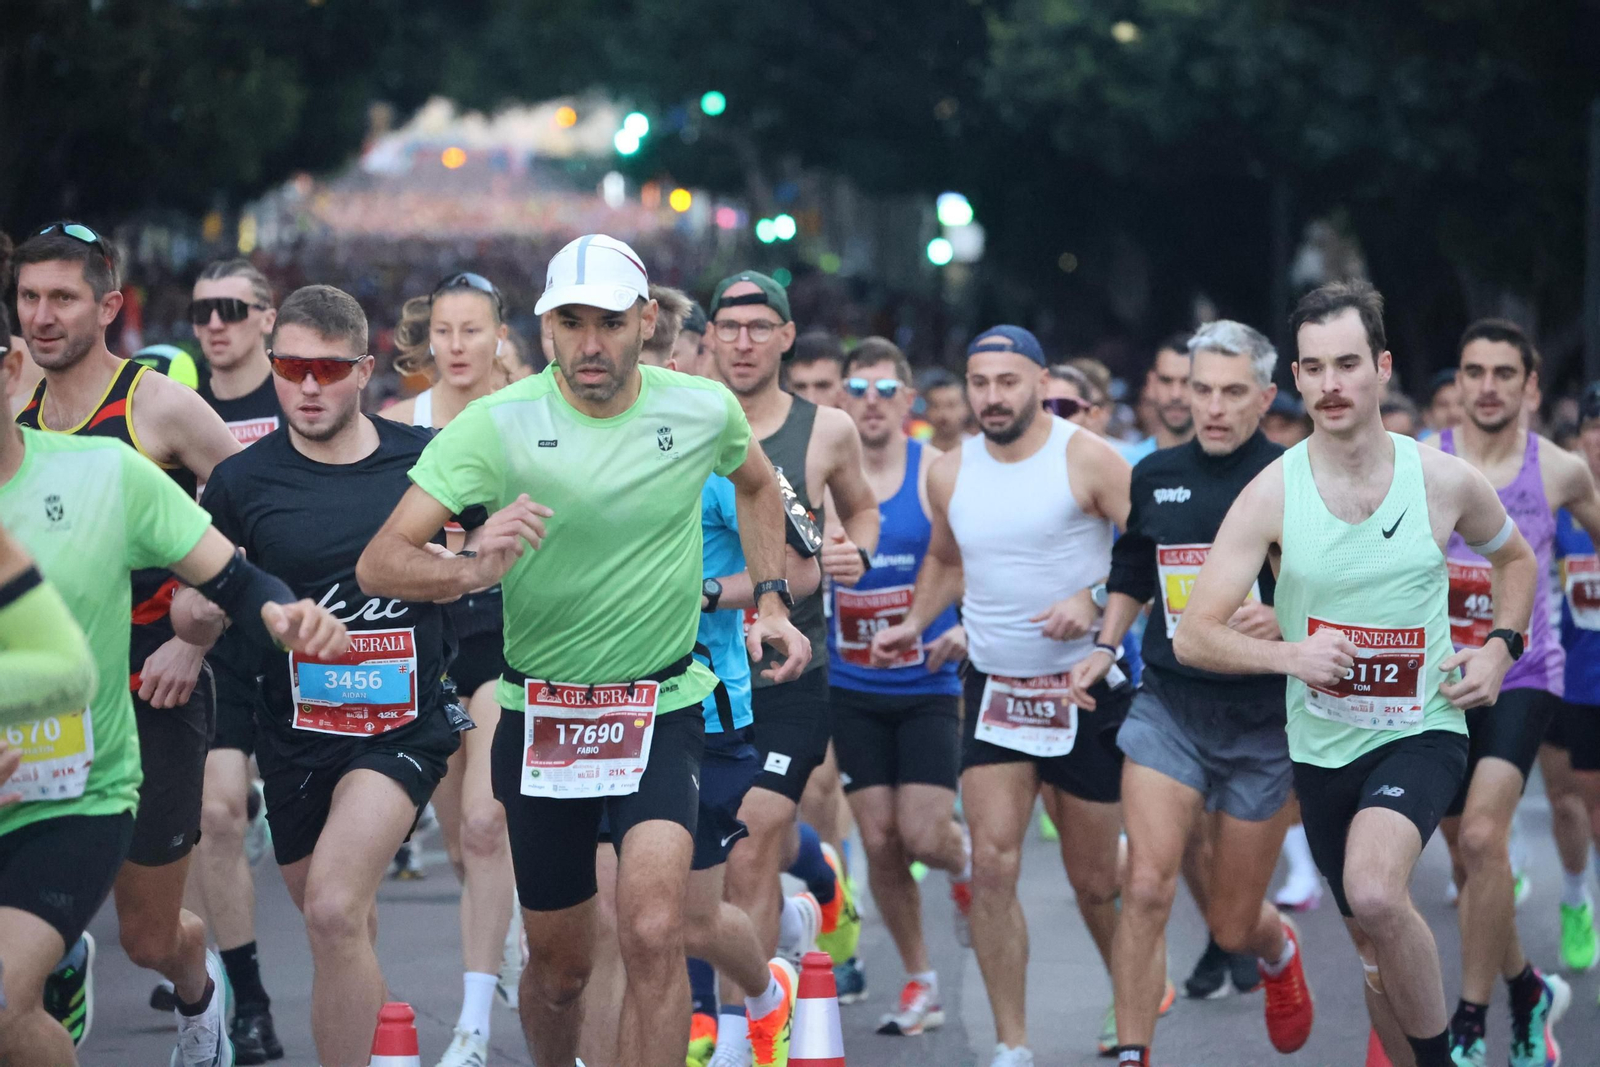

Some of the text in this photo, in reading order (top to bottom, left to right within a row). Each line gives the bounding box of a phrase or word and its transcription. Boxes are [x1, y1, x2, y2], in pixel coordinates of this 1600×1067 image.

[347, 636, 405, 654] NERALI
[324, 670, 382, 690] 3456
[1353, 683, 1371, 692] TOM
[342, 691, 367, 699] AIDAN
[563, 687, 649, 706] GENERALI
[377, 711, 399, 719] 42K
[556, 722, 624, 745] 17690
[576, 746, 600, 755] FABIO
[608, 767, 626, 777] 21K
